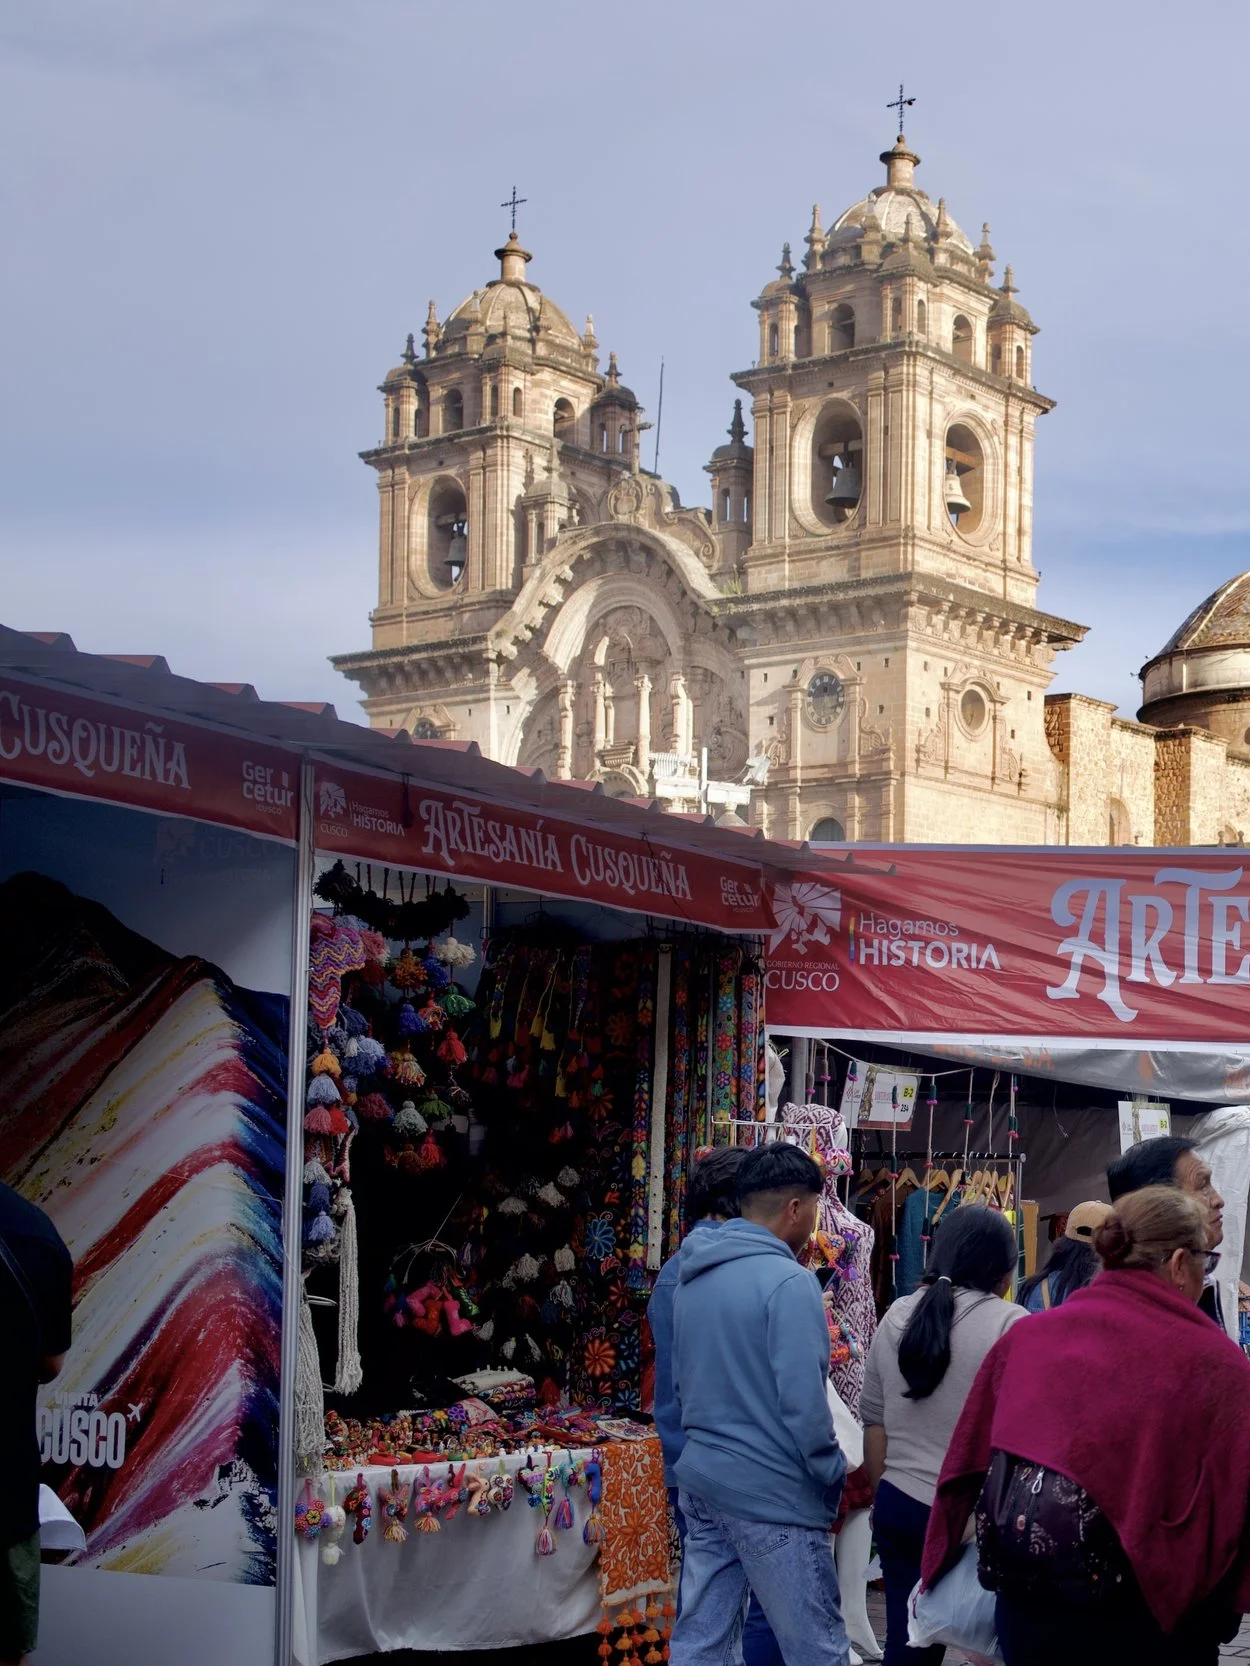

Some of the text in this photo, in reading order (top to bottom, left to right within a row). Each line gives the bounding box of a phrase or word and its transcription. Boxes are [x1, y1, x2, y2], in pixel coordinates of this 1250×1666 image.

[0, 690, 192, 790] CUSQUEÑA
[242, 761, 274, 783] Ger
[242, 778, 294, 808] cetur
[352, 801, 390, 819] Hagamos
[320, 823, 348, 838] CUSCO
[353, 814, 405, 837] HISTORIA
[419, 799, 694, 900] ARTESANÍA CUSQUEÑA
[720, 876, 738, 892] Ger
[721, 891, 759, 907] cetur
[860, 912, 959, 940] Hagamos
[766, 960, 840, 971] GOBIERNO REGIONAL
[859, 939, 1001, 970] HISTORIA
[766, 970, 840, 992] CUSCO
[903, 1088, 914, 1098] B-2
[36, 1407, 126, 1469] CUSCO
